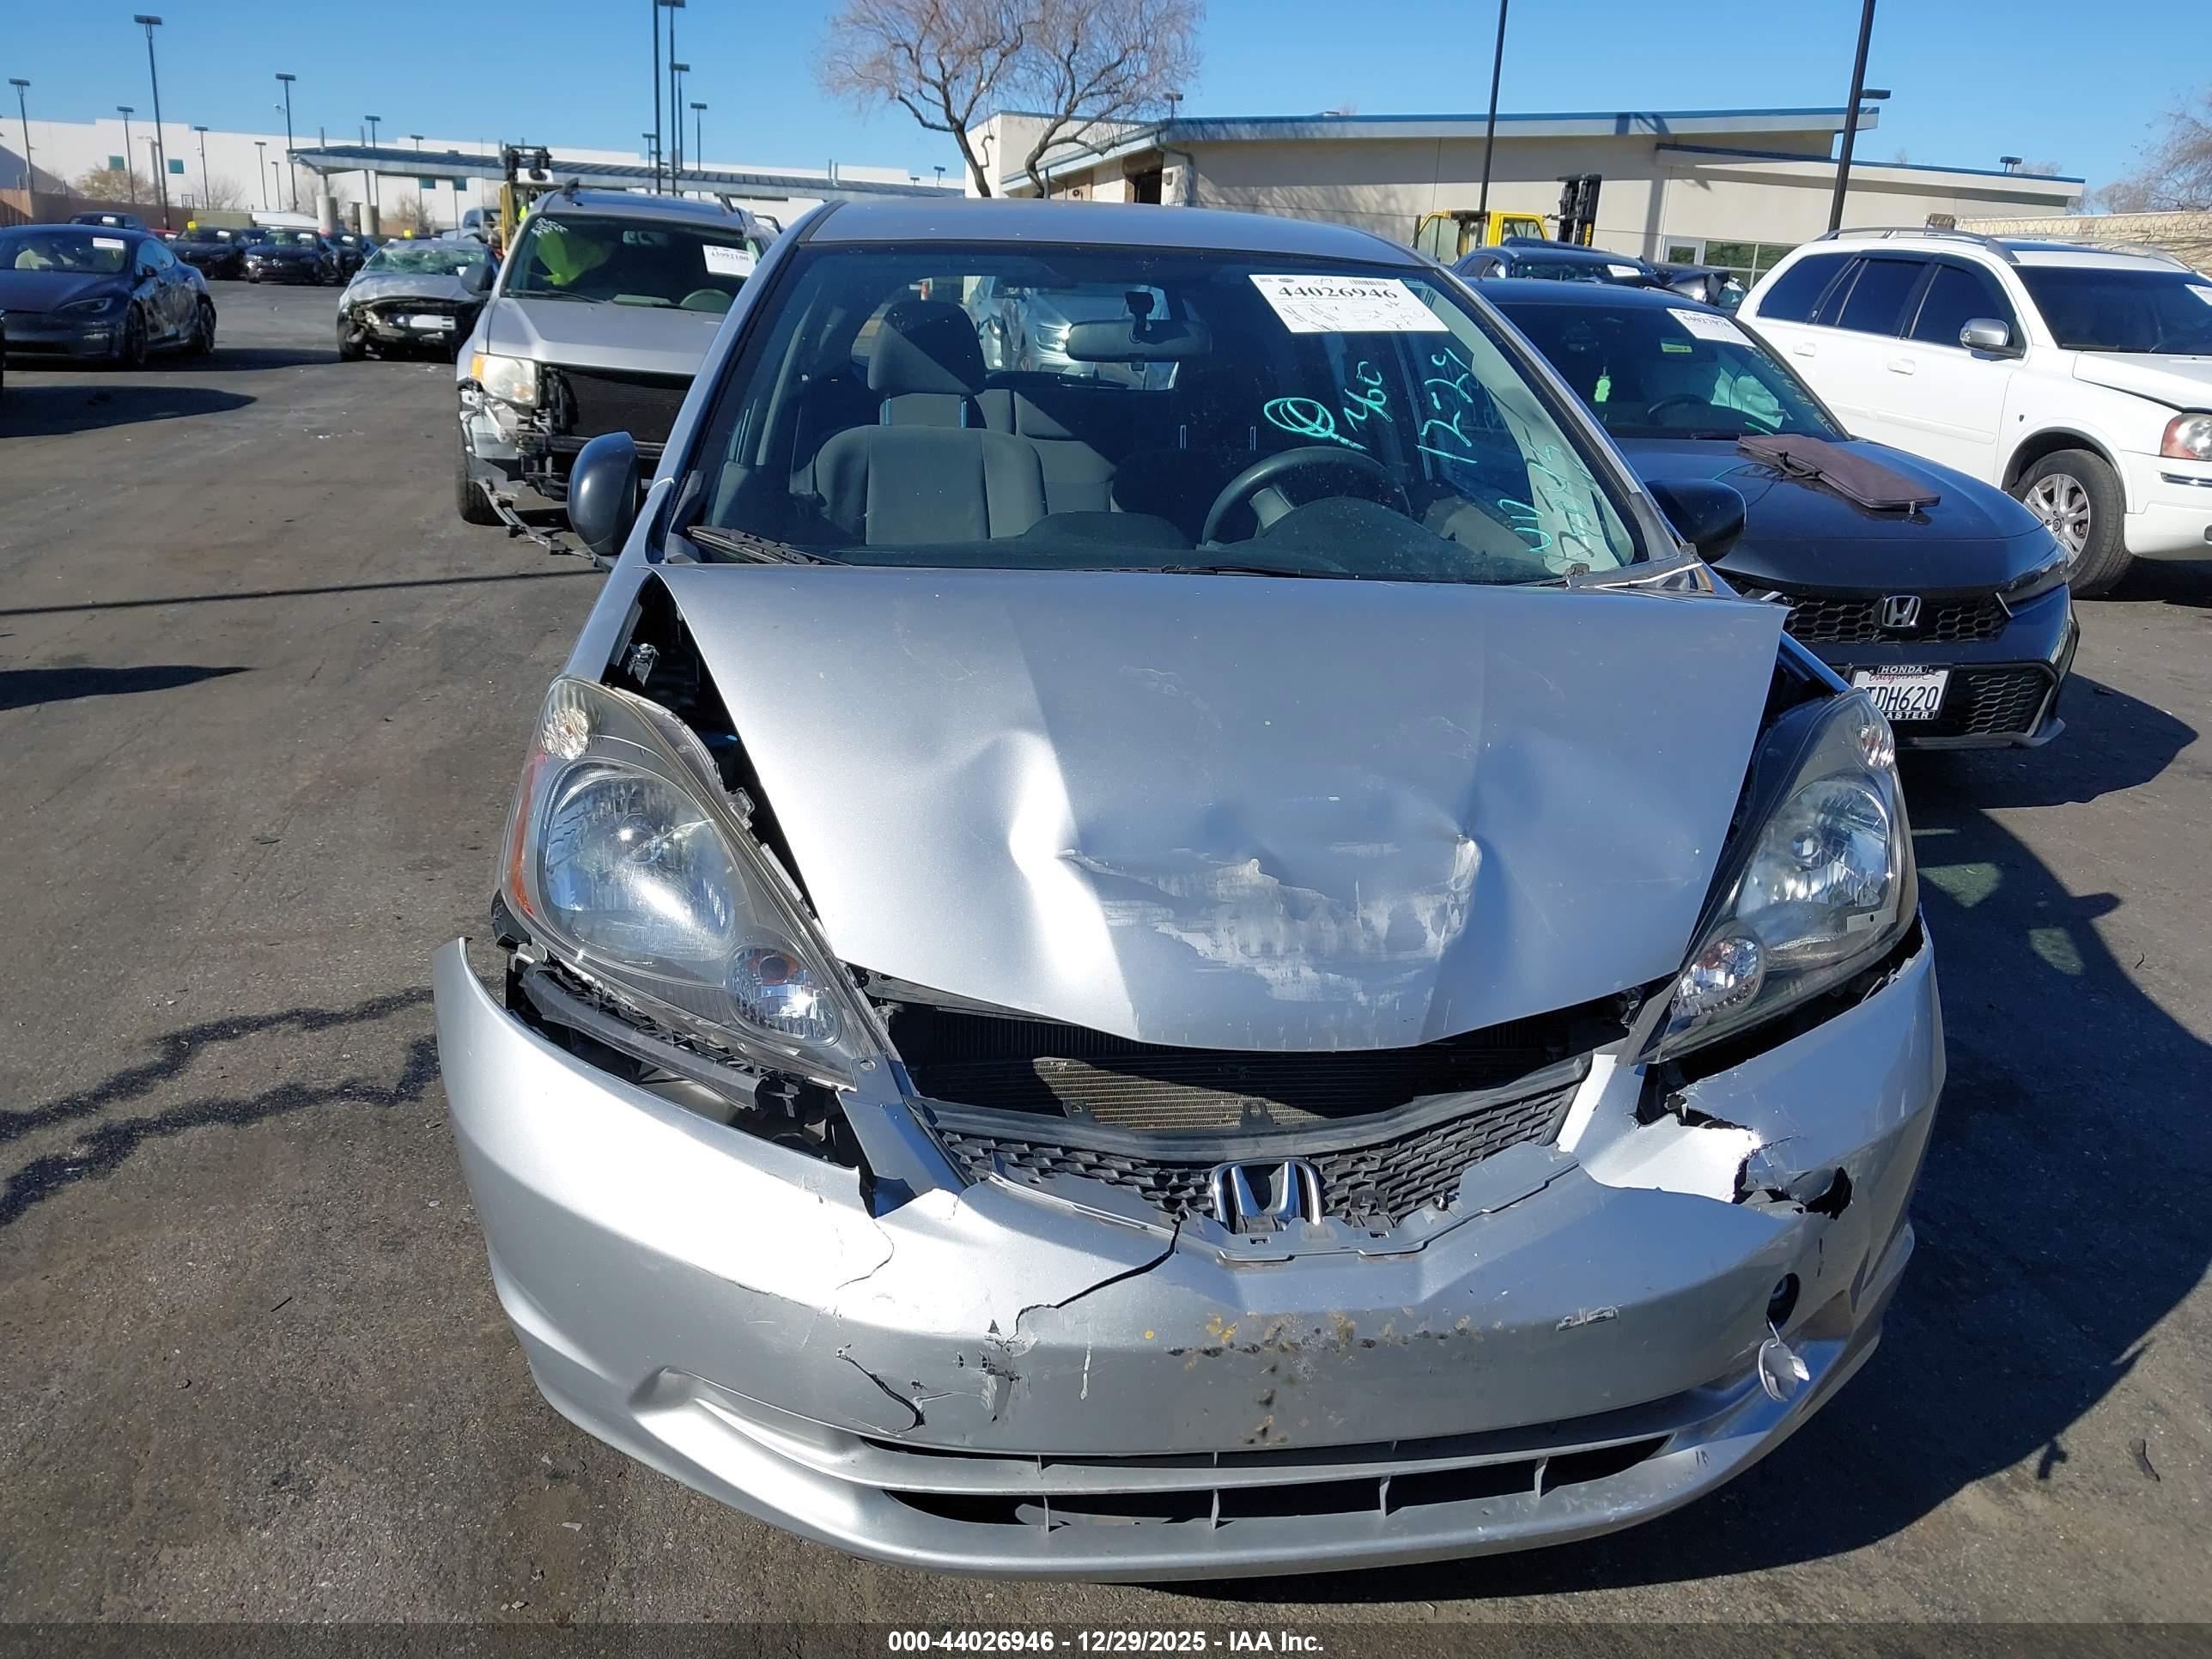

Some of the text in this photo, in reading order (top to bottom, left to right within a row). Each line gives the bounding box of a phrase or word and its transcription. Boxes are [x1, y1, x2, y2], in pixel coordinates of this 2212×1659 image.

[1278, 286, 1399, 300] 44026946
[1880, 665, 1923, 674] HONDA
[1865, 685, 1940, 712] TDH620
